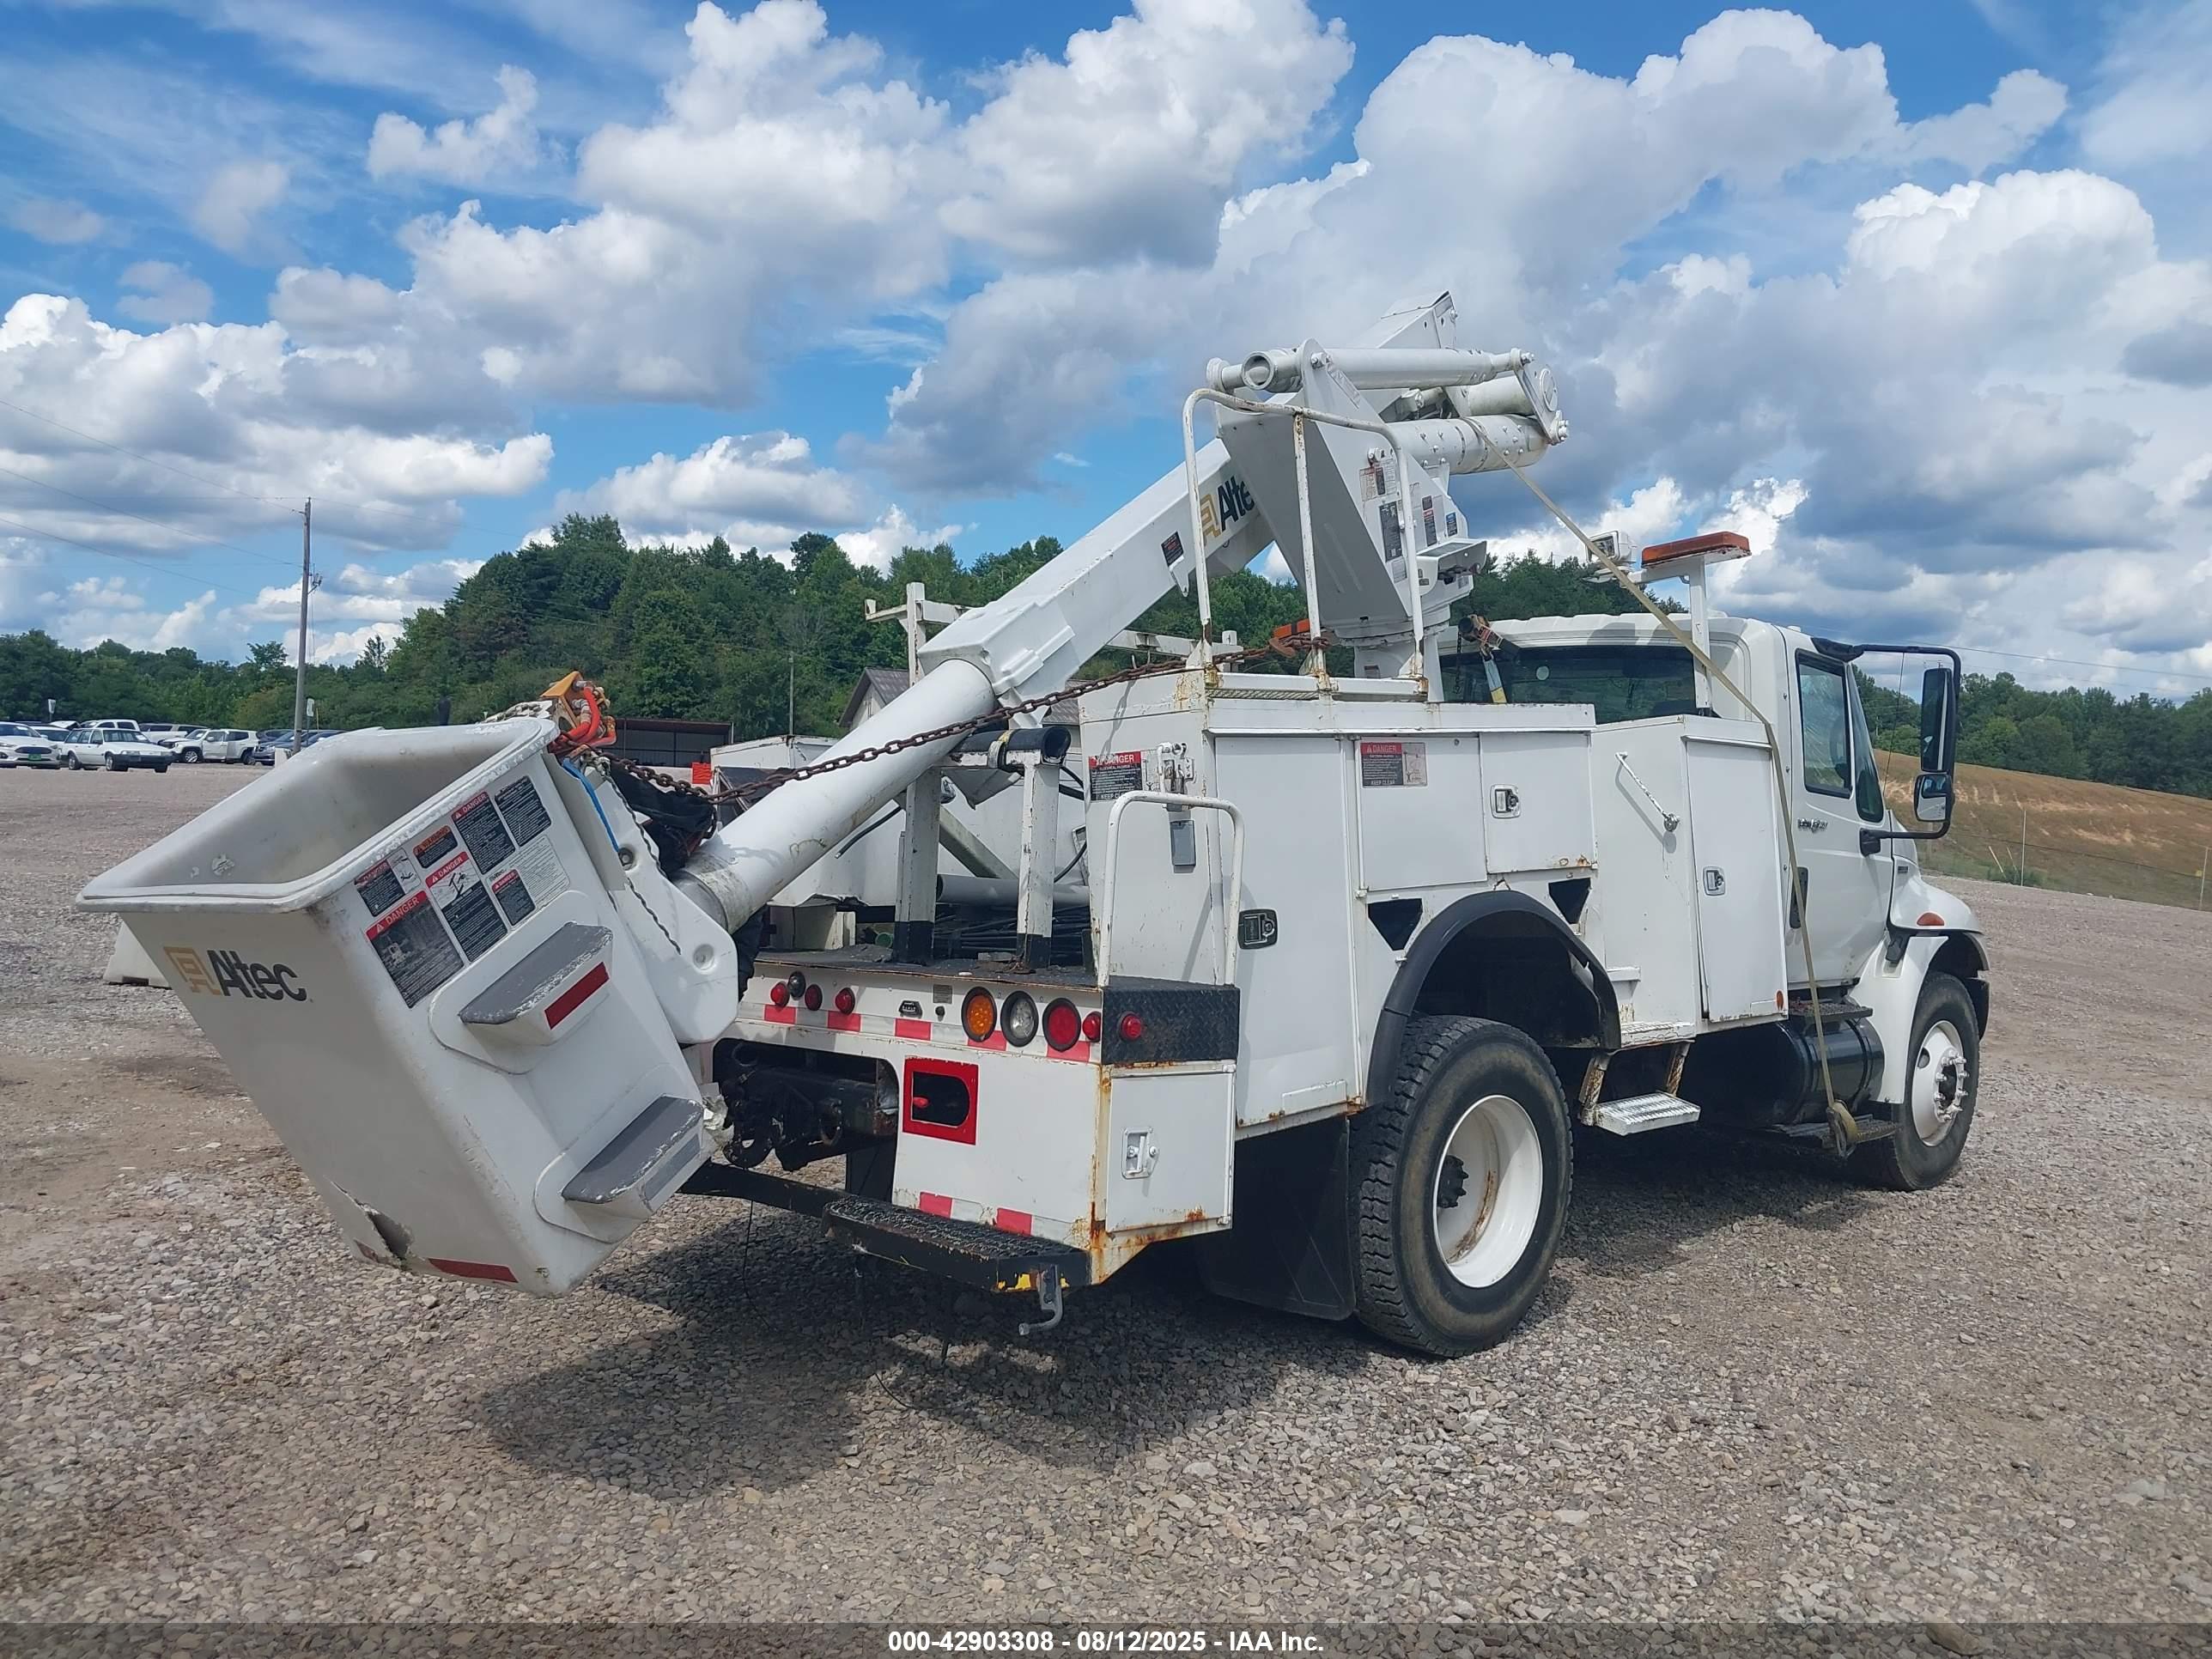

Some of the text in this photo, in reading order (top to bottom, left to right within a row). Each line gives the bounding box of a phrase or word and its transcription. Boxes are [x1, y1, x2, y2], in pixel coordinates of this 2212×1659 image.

[1217, 475, 1255, 532] Alte
[1374, 744, 1397, 754] DANGER
[463, 793, 487, 812] DANGER
[438, 856, 463, 877] DANGER
[386, 896, 420, 925] DANGER
[207, 949, 307, 1002] Altec
